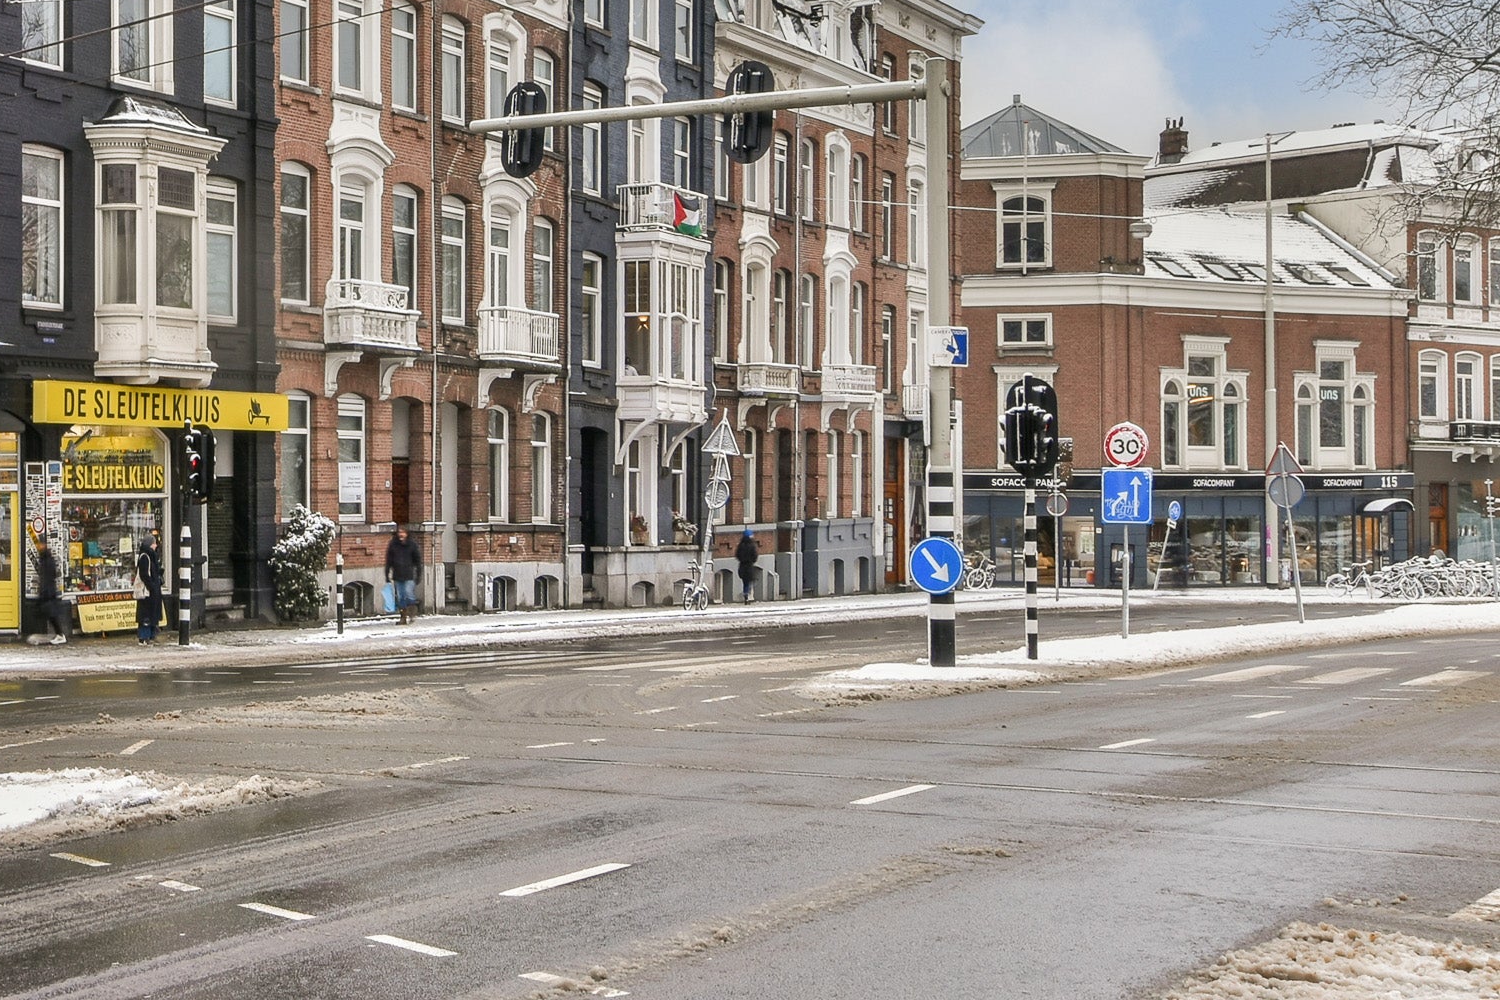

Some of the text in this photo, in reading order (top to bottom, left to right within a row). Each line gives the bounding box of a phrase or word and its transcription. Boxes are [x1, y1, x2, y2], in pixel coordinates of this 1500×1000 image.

[1189, 386, 1209, 397] uns
[1320, 388, 1339, 400] uns
[64, 388, 221, 424] DE SLEUTELKLUIS
[1112, 438, 1140, 455] 30
[75, 464, 164, 490] SLEUTELKLUIS
[1193, 478, 1236, 488] SOFACOMPANY
[1323, 478, 1363, 488] SOFACOMPANY
[1380, 475, 1398, 488] 115
